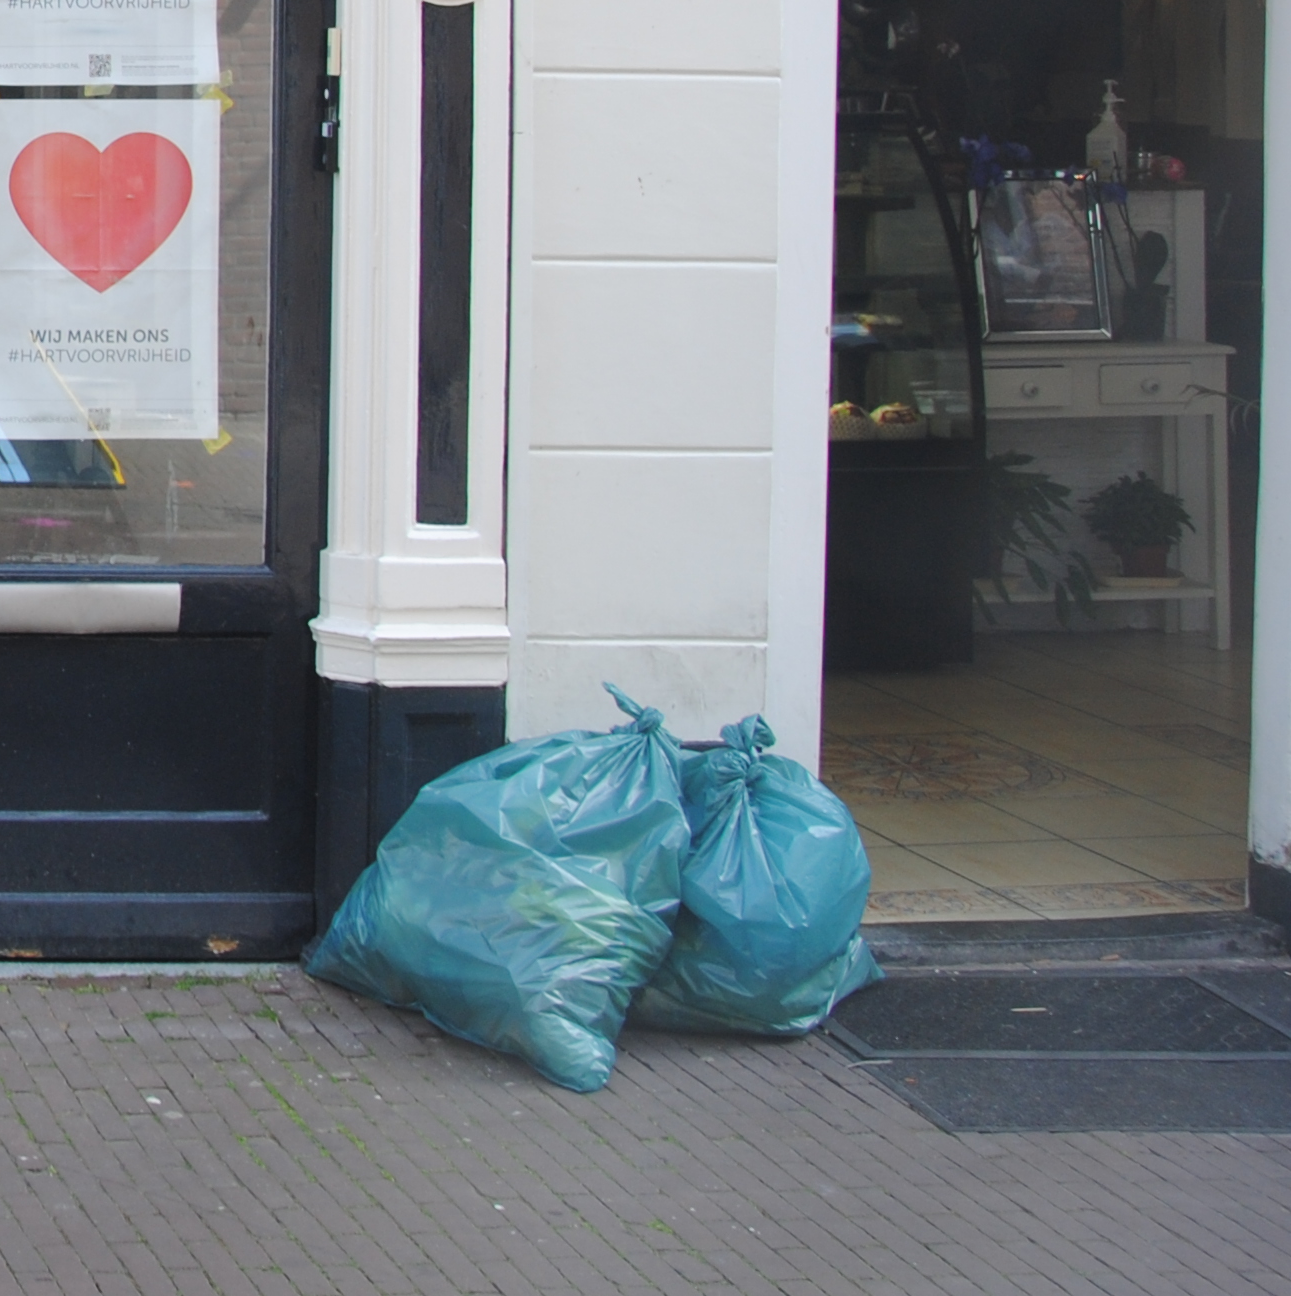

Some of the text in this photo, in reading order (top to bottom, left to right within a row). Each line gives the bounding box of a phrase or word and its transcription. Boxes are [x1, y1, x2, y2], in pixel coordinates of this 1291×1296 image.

[30, 328, 170, 344] WIJ MAKEN ONS
[7, 347, 192, 364] #HARTVOORVRIJHEID
